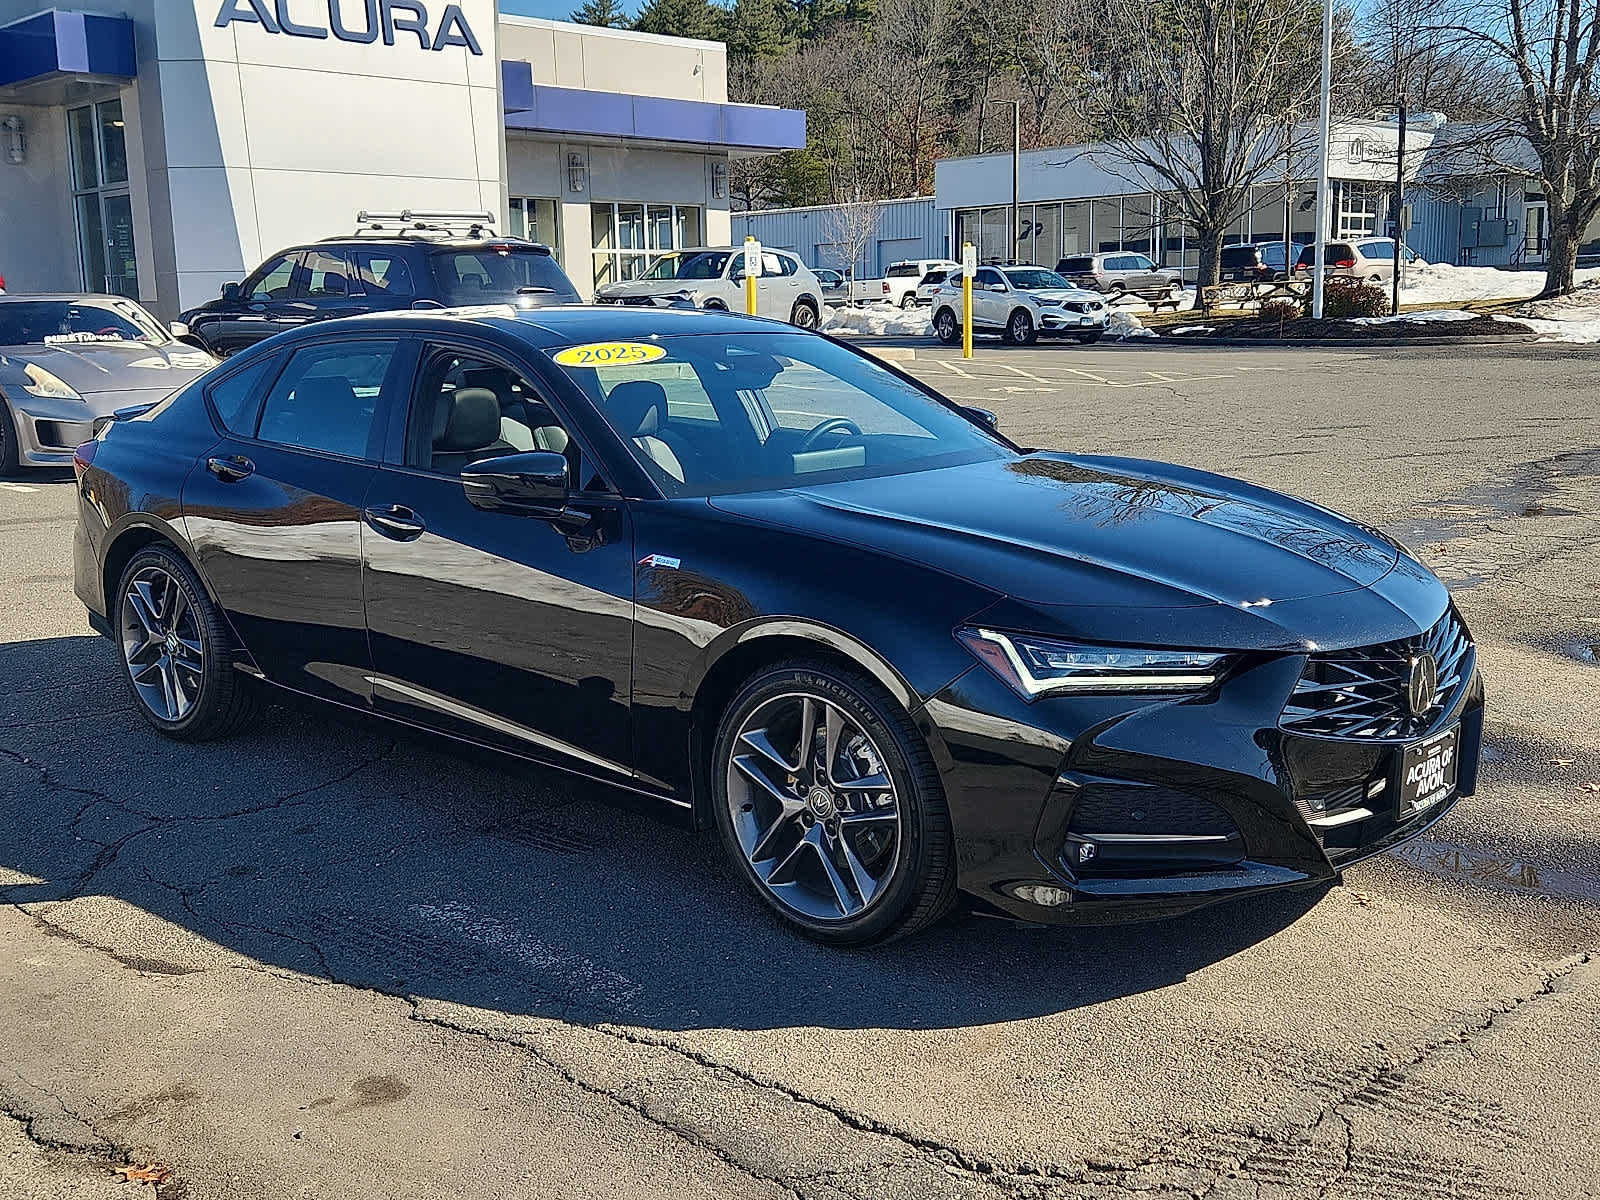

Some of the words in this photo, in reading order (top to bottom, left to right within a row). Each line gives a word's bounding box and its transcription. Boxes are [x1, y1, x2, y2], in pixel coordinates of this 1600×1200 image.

[214, 0, 484, 56] ACURA
[577, 346, 647, 363] 2025
[815, 678, 875, 721] MICHELIN
[1406, 754, 1441, 785] ACURA
[1441, 745, 1454, 768] OF
[1416, 767, 1445, 798] AVON
